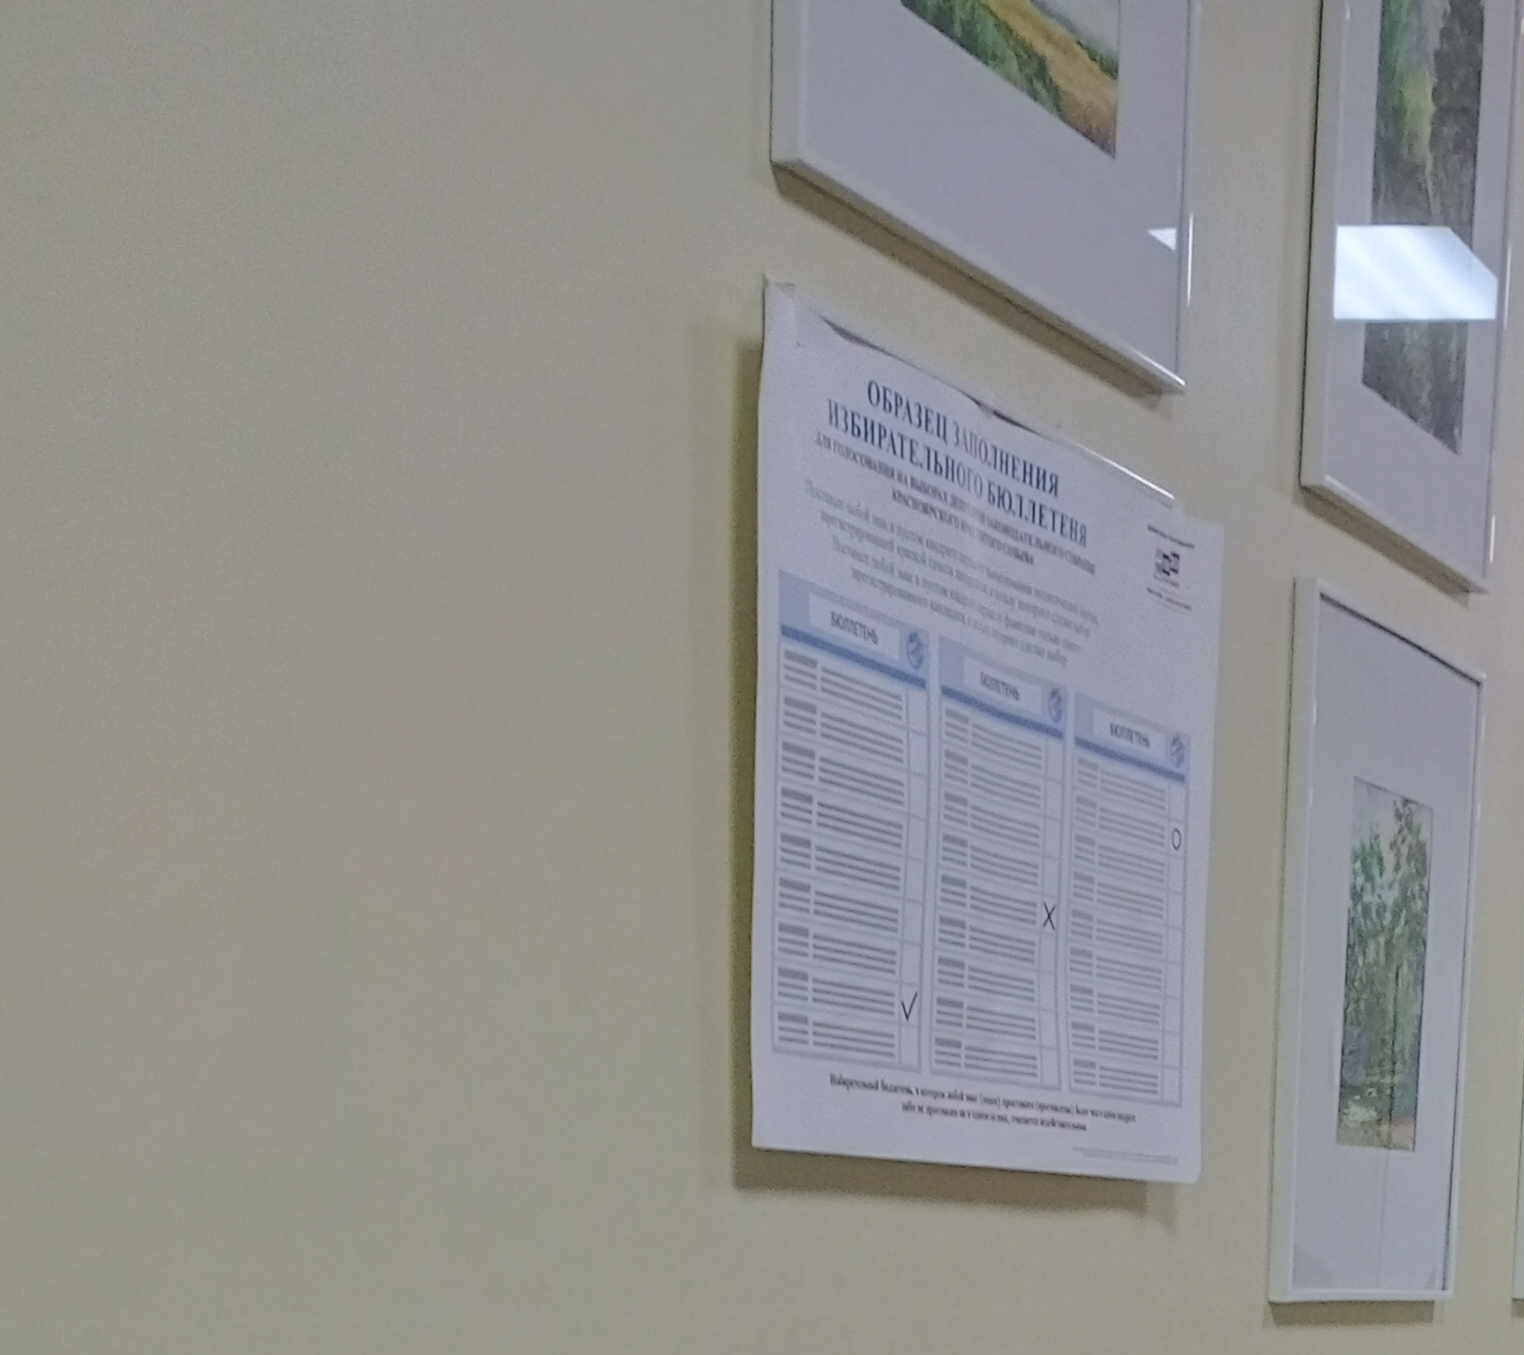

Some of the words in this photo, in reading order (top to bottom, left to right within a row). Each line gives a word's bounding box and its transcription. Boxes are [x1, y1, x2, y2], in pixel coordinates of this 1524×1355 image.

[828, 398, 983, 498] ИЗБИРАТЕЛЬНОГО
[987, 479, 1087, 548] БЮЛЛЕТЕНЯ
[867, 379, 948, 445] ОБРАЗЕЦ
[953, 420, 1059, 498] ЗАПОЛНЕНИЯ
